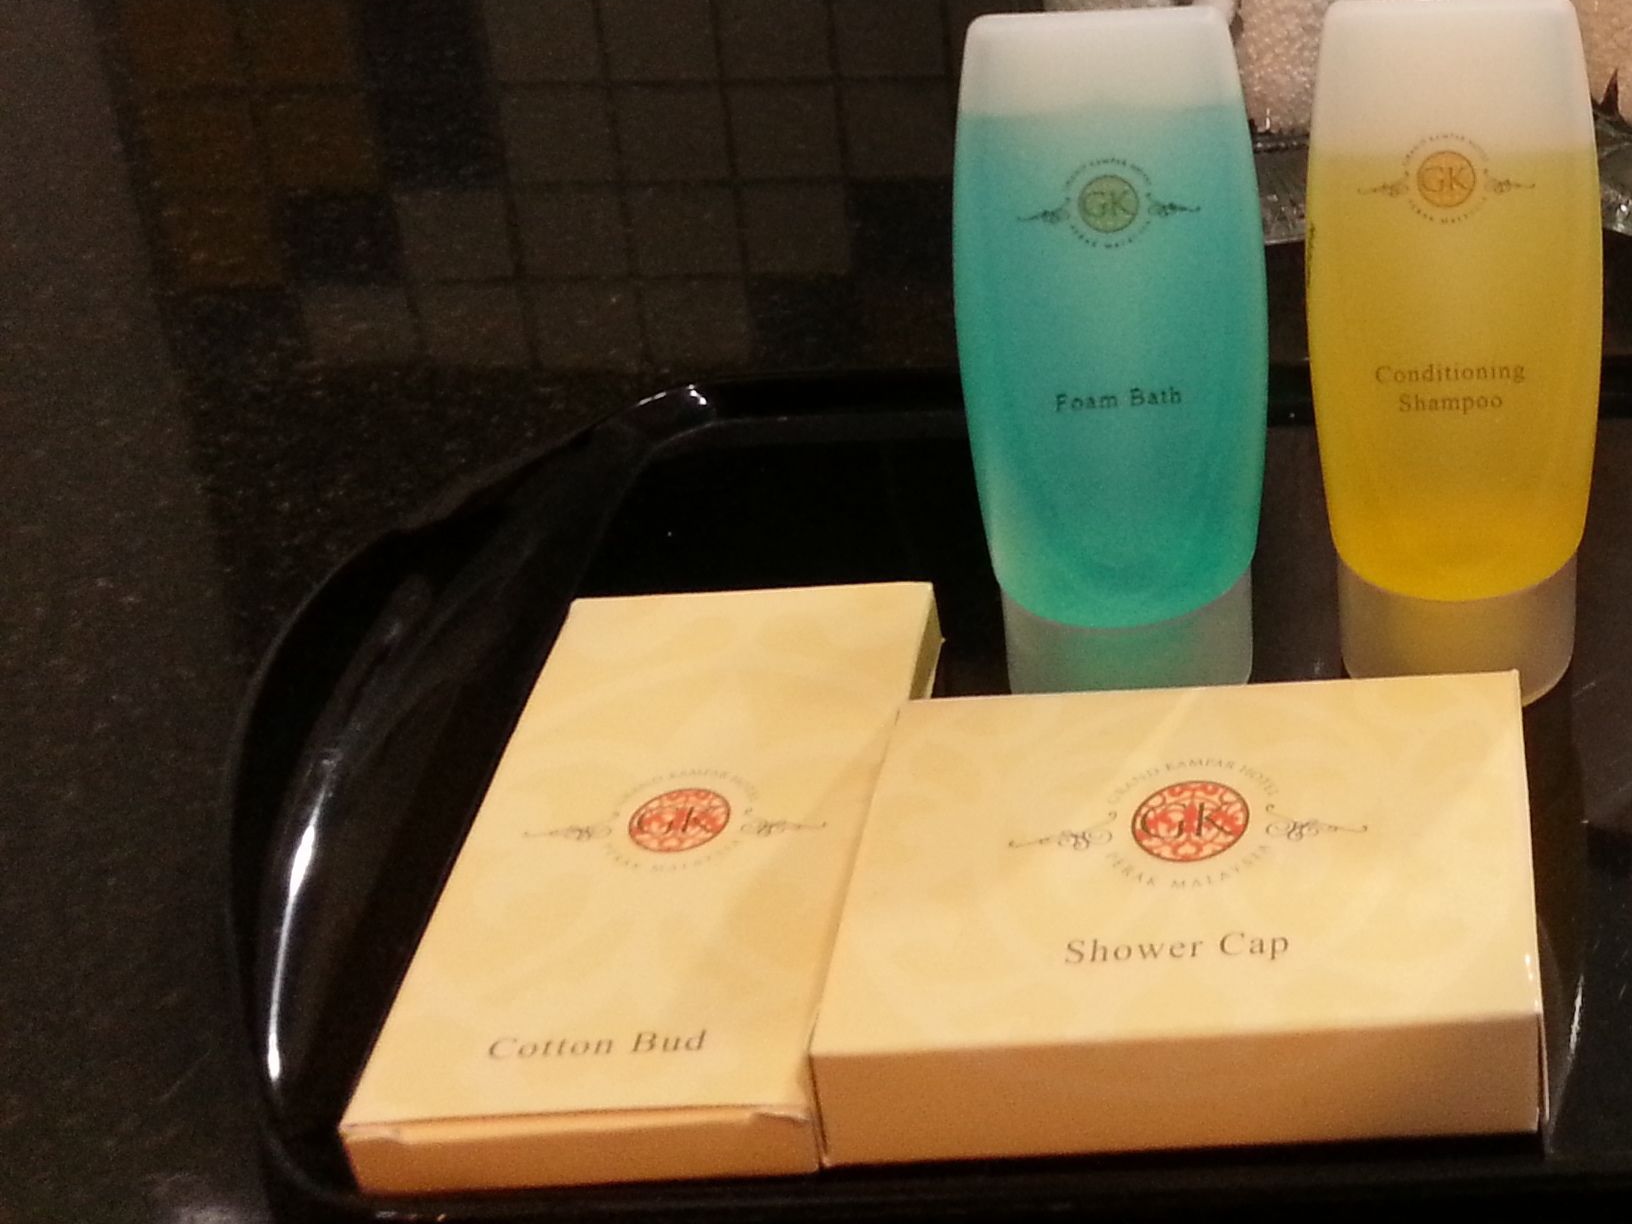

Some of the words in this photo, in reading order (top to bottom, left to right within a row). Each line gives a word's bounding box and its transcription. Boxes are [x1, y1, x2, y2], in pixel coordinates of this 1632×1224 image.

[1374, 361, 1526, 385] Conditioning
[1055, 391, 1118, 413] Foam
[1129, 386, 1183, 407] Bath
[1398, 391, 1504, 416] Shampoo
[1165, 757, 1236, 772] KAMPAR
[1064, 936, 1204, 965] Shower
[1219, 930, 1290, 960] Cap
[487, 1035, 614, 1060] Cotton
[630, 1029, 708, 1055] Bud
